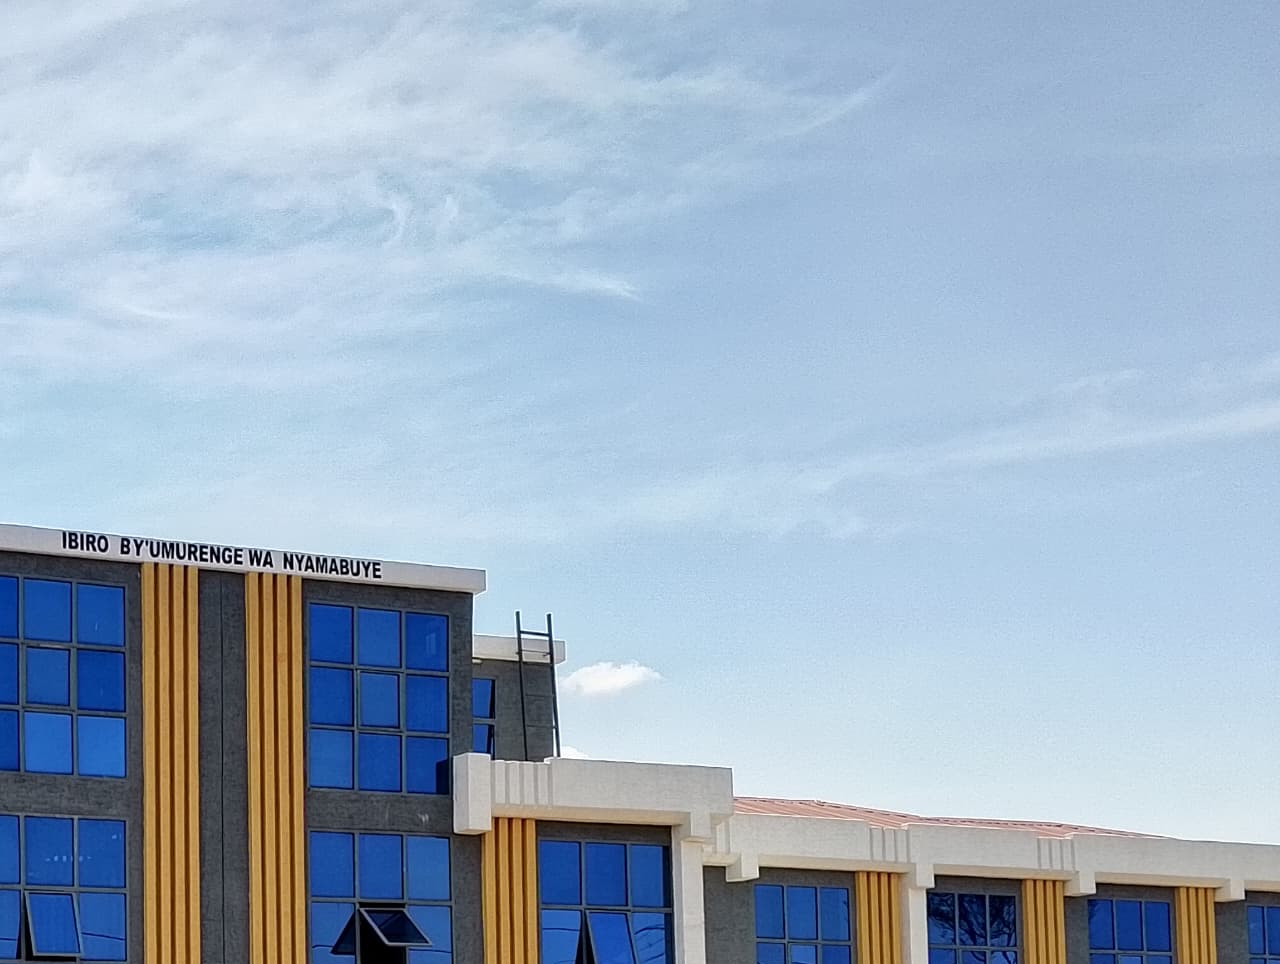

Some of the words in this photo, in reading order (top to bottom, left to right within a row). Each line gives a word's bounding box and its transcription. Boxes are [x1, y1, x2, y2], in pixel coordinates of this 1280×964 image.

[62, 531, 109, 553] IBIRO
[120, 537, 244, 566] BY'UMURENGE
[248, 549, 274, 568] WA
[283, 552, 382, 579] NYAMABUYE
